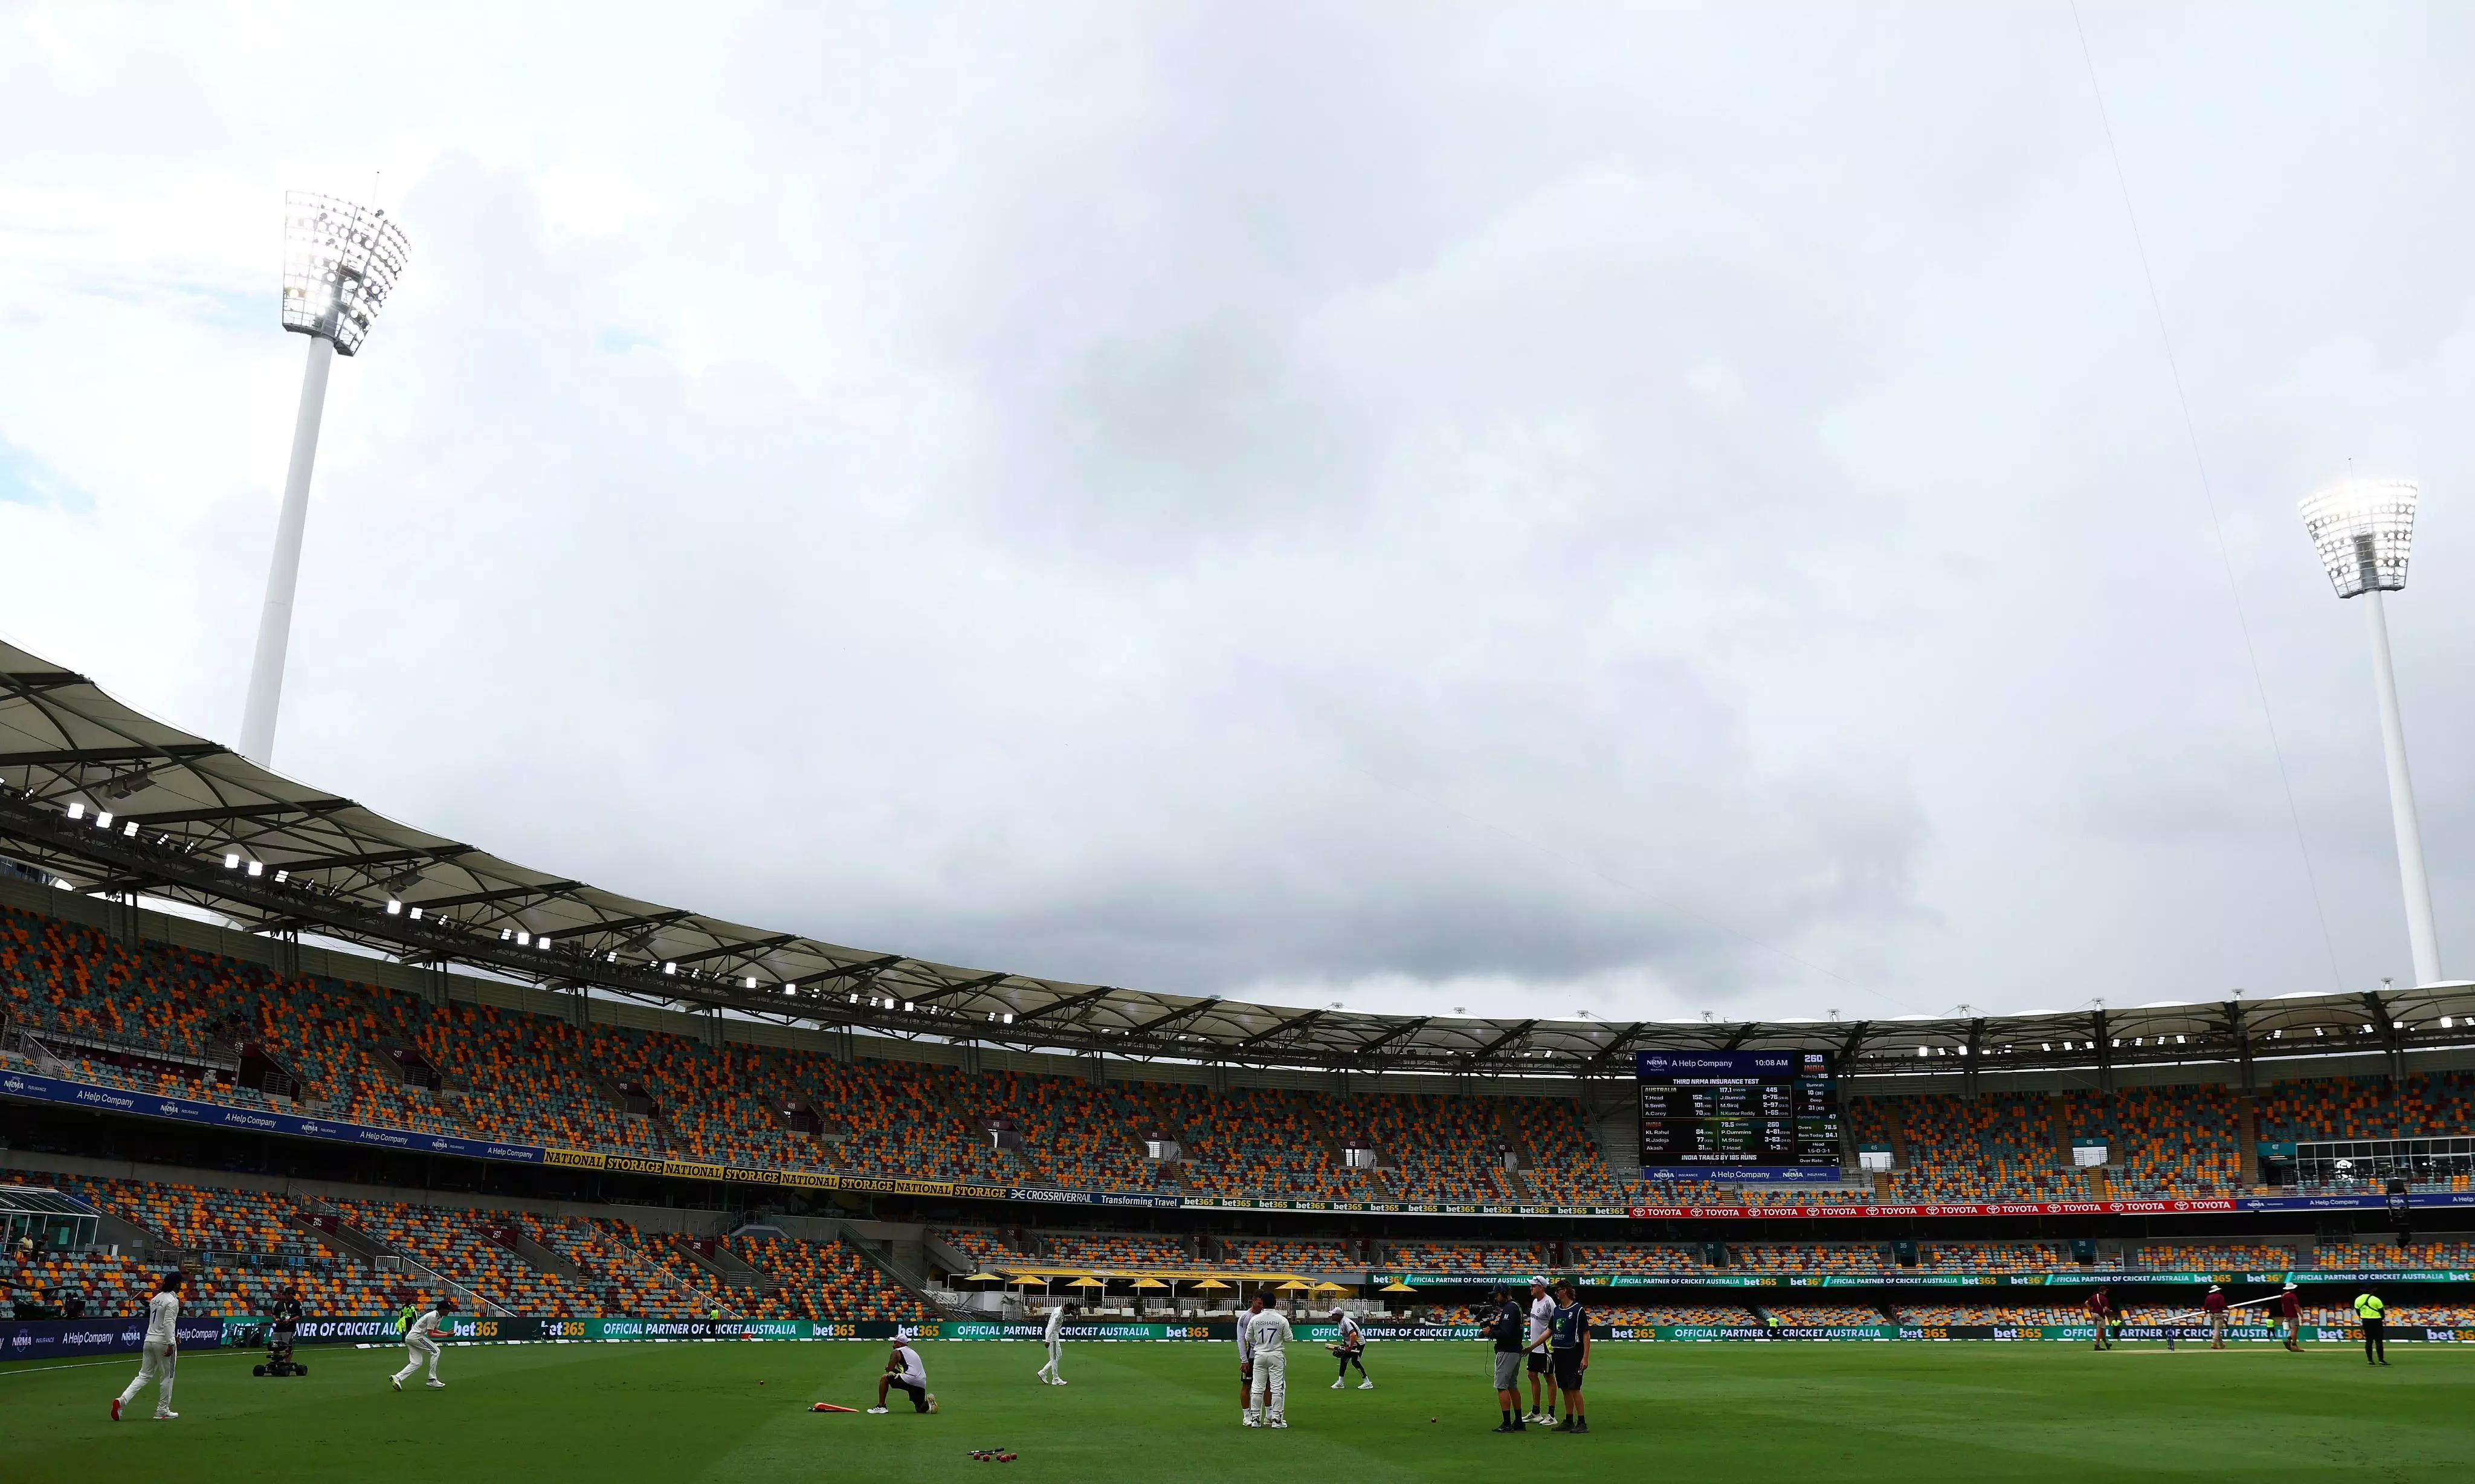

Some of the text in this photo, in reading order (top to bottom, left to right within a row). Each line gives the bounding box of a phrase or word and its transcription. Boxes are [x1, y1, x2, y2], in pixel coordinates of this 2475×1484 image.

[4, 1080, 24, 1090] NRMA
[77, 1090, 134, 1108] A Help Company
[160, 1105, 178, 1114] NRMA
[231, 1114, 247, 1124] Help
[247, 1116, 276, 1128] Company
[366, 1131, 379, 1141] Help
[380, 1134, 408, 1145] Company
[493, 1148, 508, 1157] Help
[508, 1149, 533, 1159] Company
[544, 1149, 1007, 1198] NATIONAL STORAGE NATIONAL STORAGE NATIONAL STORAGE NATIONAL STORAGE
[1101, 1195, 1177, 1207] Transforming Travel
[1222, 1199, 1251, 1207] bet365
[1259, 1200, 1288, 1208] bet365
[1296, 1201, 1326, 1210] bet365
[1446, 1205, 1475, 1213] bet365
[1520, 1206, 1549, 1215] bet365
[2063, 1204, 2102, 1212] TOYOTA
[2126, 1202, 2165, 1211] TOYOTA
[1744, 1277, 1776, 1286] bet365
[1962, 1276, 1996, 1285] bet365
[2194, 1274, 2231, 1282] bet365
[152, 1308, 157, 1324] 1
[337, 1322, 381, 1337] CRICKET
[454, 1321, 498, 1337] bet365
[604, 1323, 796, 1334] OFFICIAL PARTNER OF AUSTRALIA
[813, 1323, 856, 1337] bet365
[898, 1324, 939, 1337] bet365
[957, 1326, 1043, 1335] OFFICIAL PARTNER
[1060, 1327, 1149, 1337] CRICKET AUSTRALIA
[1166, 1326, 1209, 1338] bet365
[1398, 1328, 1453, 1337] OF CRICKET
[1612, 1328, 1656, 1339] bet365
[1675, 1329, 1763, 1338] OFFICIAL PARTNER
[1783, 1329, 1824, 1338] CRICKET
[1900, 1328, 1948, 1339] bet365
[1993, 1328, 2042, 1338] bet365
[63, 1332, 114, 1346] A Help Company
[121, 1332, 140, 1341] NRMA
[176, 1329, 190, 1341] Help
[191, 1329, 219, 1341] Company
[1258, 1328, 1277, 1344] 17
[12, 1337, 31, 1346] NRMA
